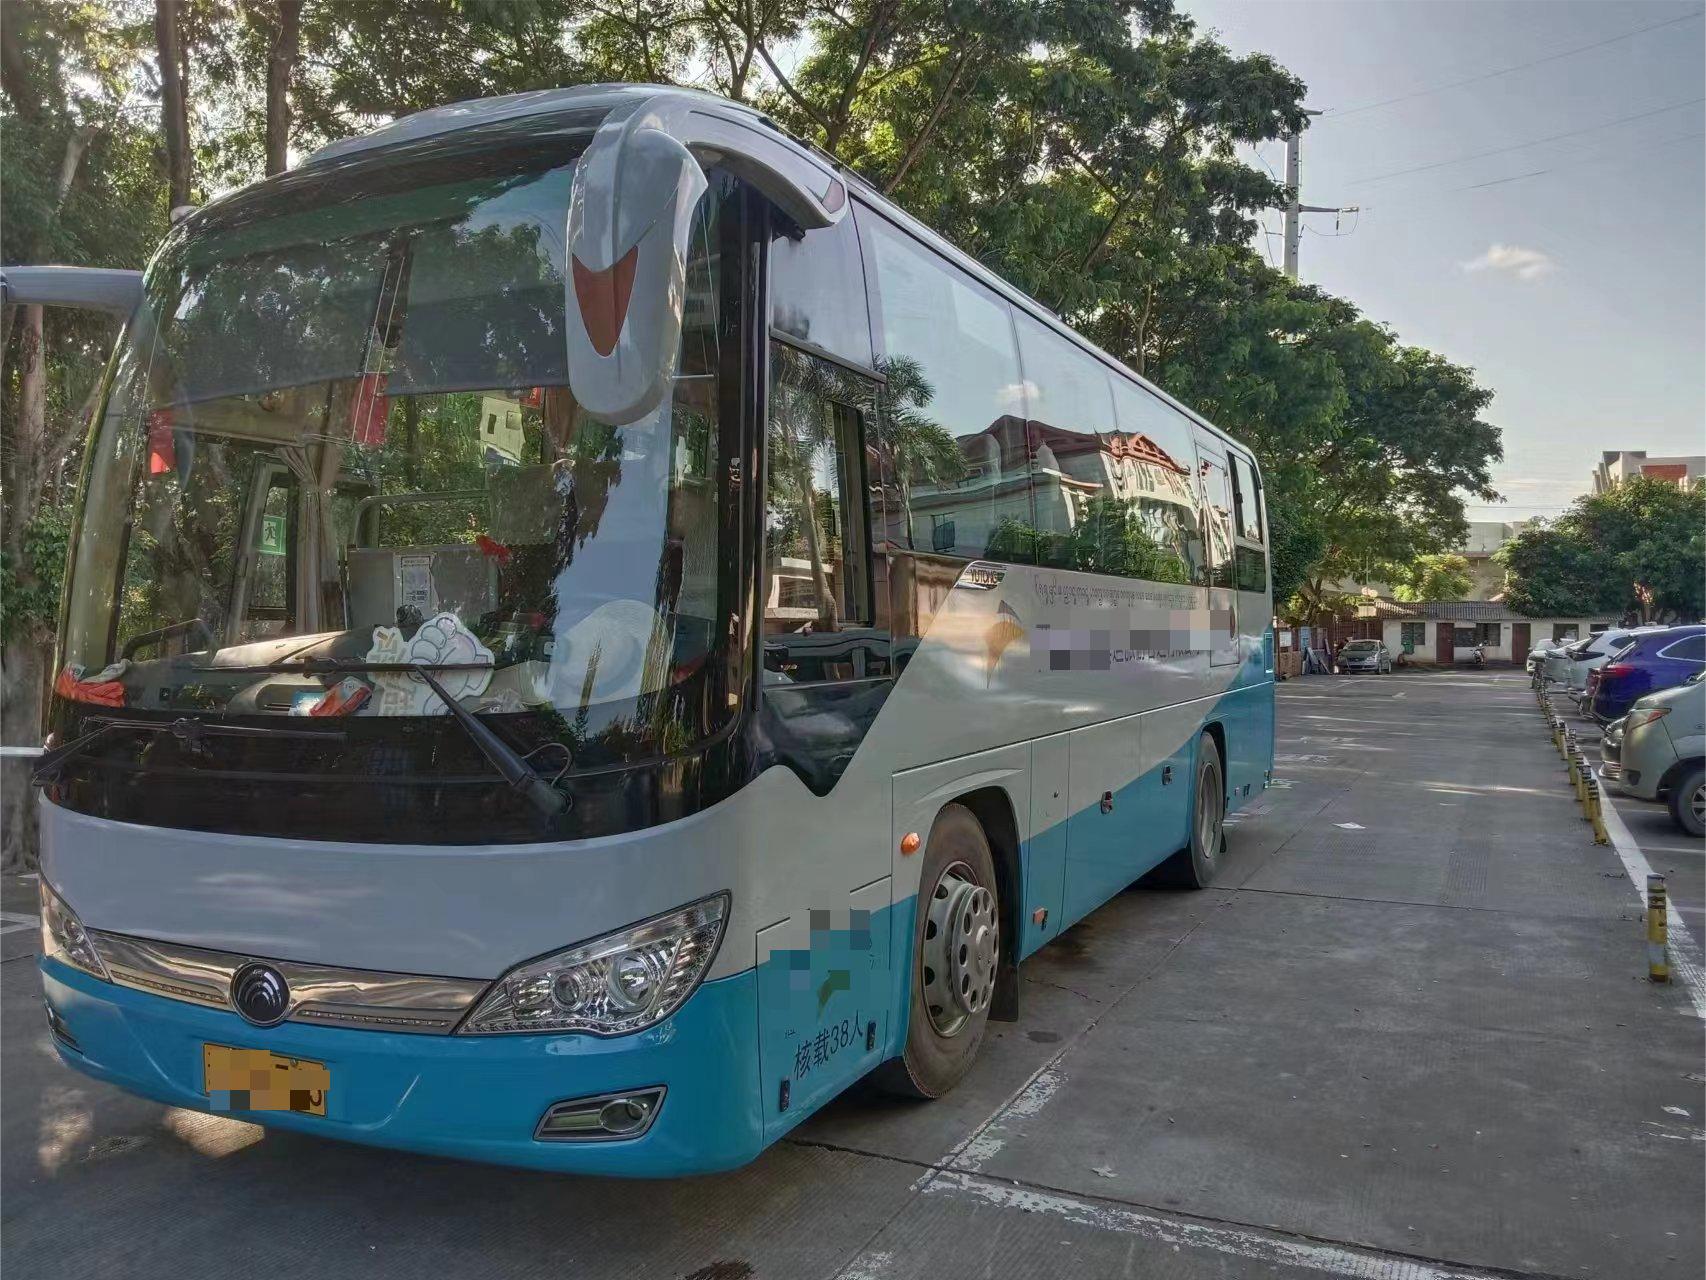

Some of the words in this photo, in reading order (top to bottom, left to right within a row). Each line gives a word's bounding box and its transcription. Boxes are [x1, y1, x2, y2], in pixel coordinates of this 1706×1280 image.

[970, 569, 998, 584] YUTONG
[794, 1011, 863, 1080] 核载38人
